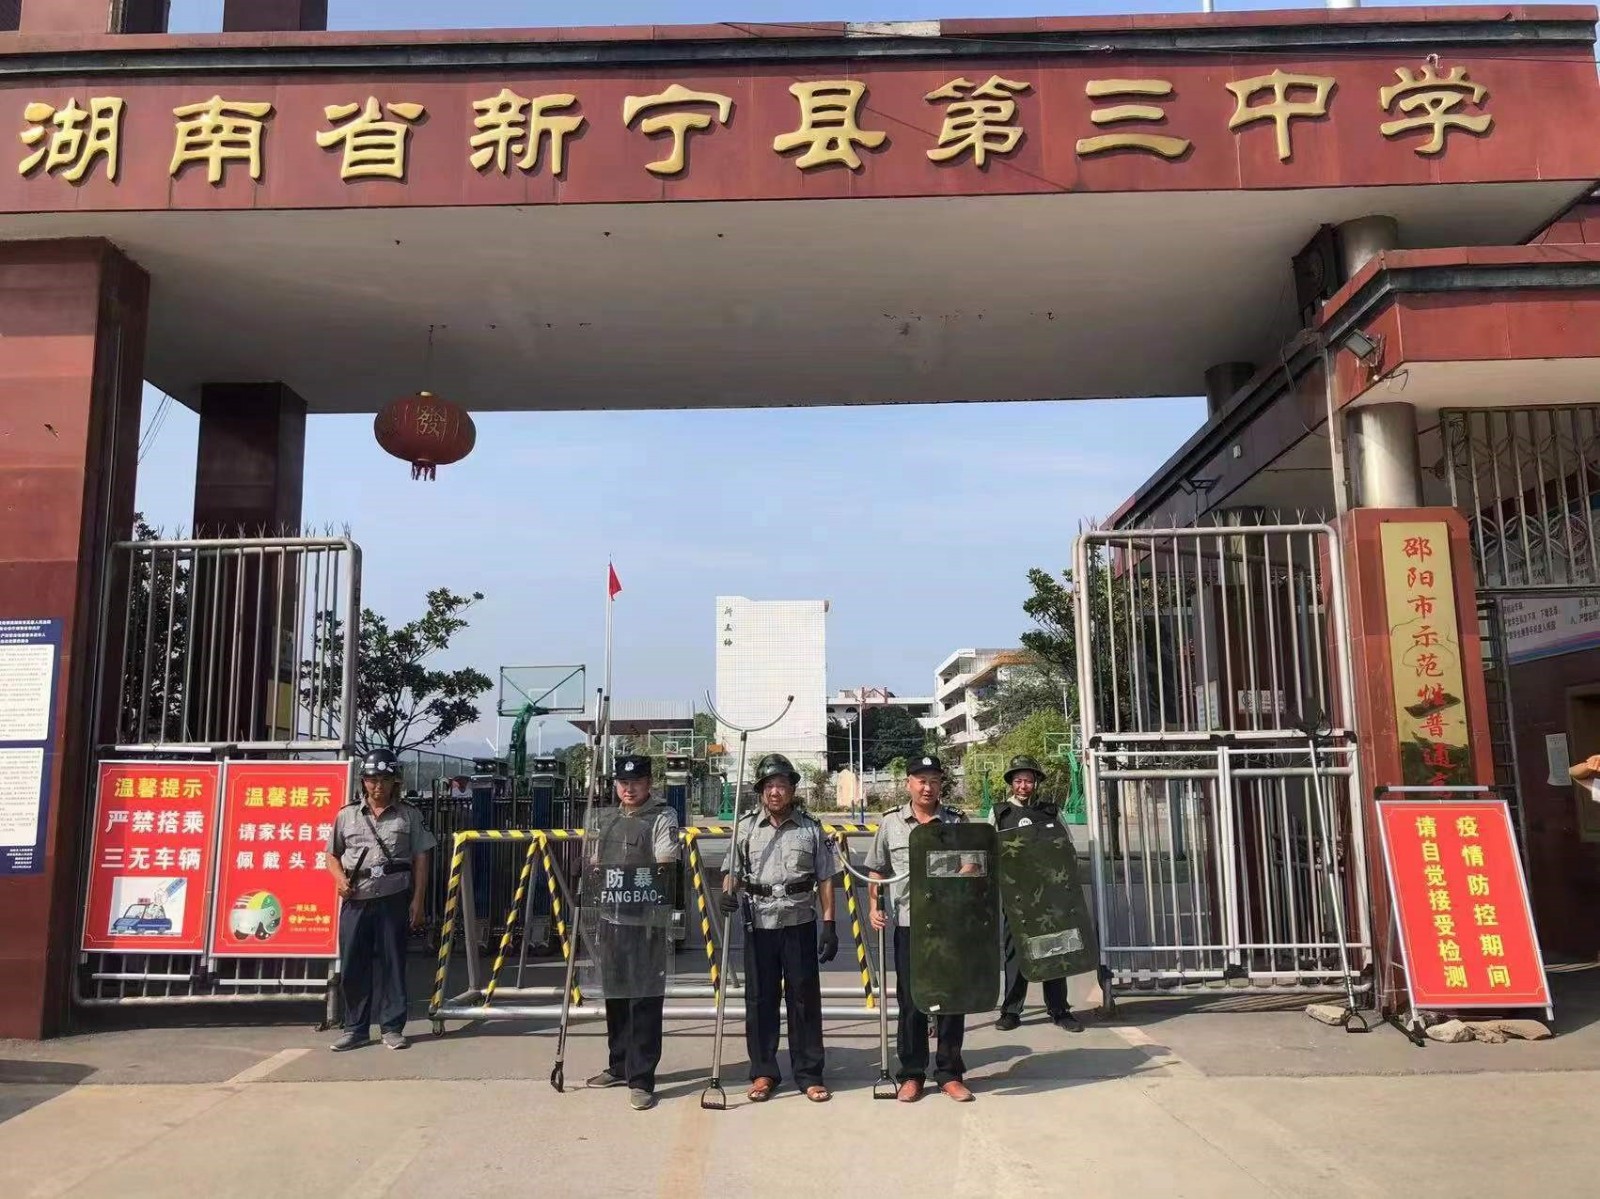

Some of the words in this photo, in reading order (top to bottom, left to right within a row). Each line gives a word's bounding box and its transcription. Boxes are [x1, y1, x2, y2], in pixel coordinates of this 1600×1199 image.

[19, 65, 1492, 184] 湖南省新宁县第三中学
[114, 777, 204, 799] 温馨提示
[244, 787, 332, 808] 温馨提示
[104, 811, 205, 834] 严禁搭乘
[238, 823, 332, 842] 请家长自觉
[101, 847, 202, 871] 三无车辆
[236, 851, 328, 871] 佩戴头盔
[605, 867, 653, 888] 防暴
[1415, 815, 1468, 988] 请自觉接受检测
[1455, 815, 1511, 988] 疫情防控期间
